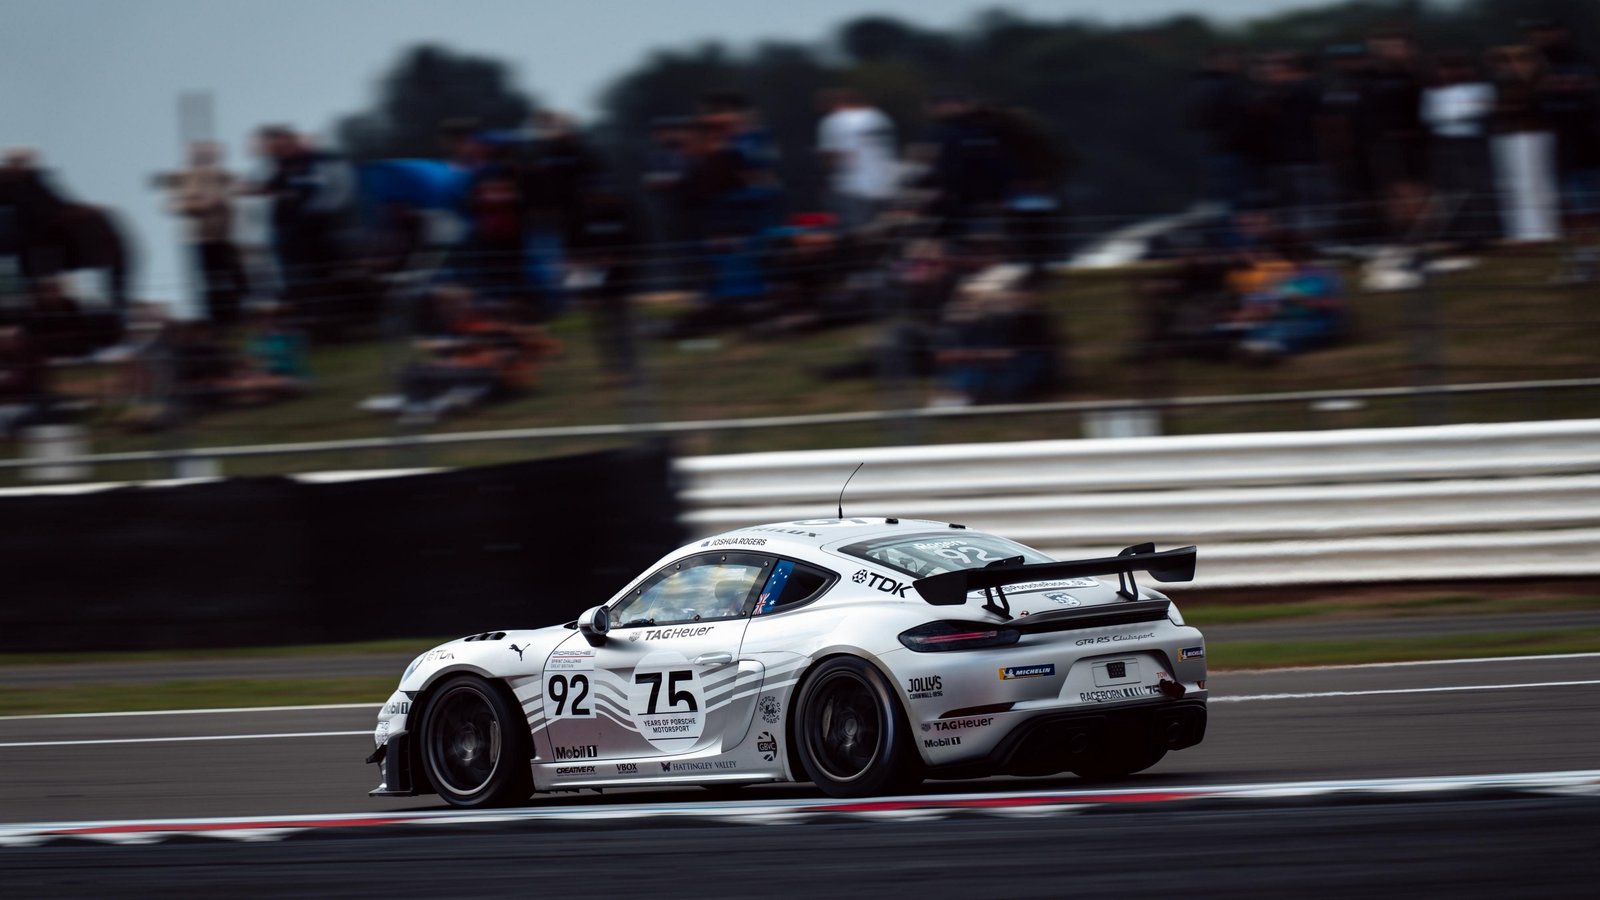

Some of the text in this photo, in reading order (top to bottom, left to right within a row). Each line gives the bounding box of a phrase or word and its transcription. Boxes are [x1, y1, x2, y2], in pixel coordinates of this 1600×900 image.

[711, 537, 767, 546] JOSHUA ROGERS
[868, 572, 913, 599] TDK
[1075, 632, 1155, 646] GT4 RS Clubsport
[1016, 667, 1051, 675] MICHELIN
[907, 675, 942, 692] JOLLY'S
[548, 674, 591, 716] 92
[635, 670, 698, 715] 75
[1080, 688, 1124, 702] RACEBORN
[643, 719, 661, 727] YEARS
[670, 717, 696, 726] PORSCHE
[652, 725, 690, 733] MOTORSPORT
[759, 743, 776, 751] GBVC
[924, 738, 951, 748] Mobil
[555, 746, 586, 759] Mobil
[616, 763, 638, 771] VBOX
[673, 761, 737, 771] HATTINGLEY VALLEY
